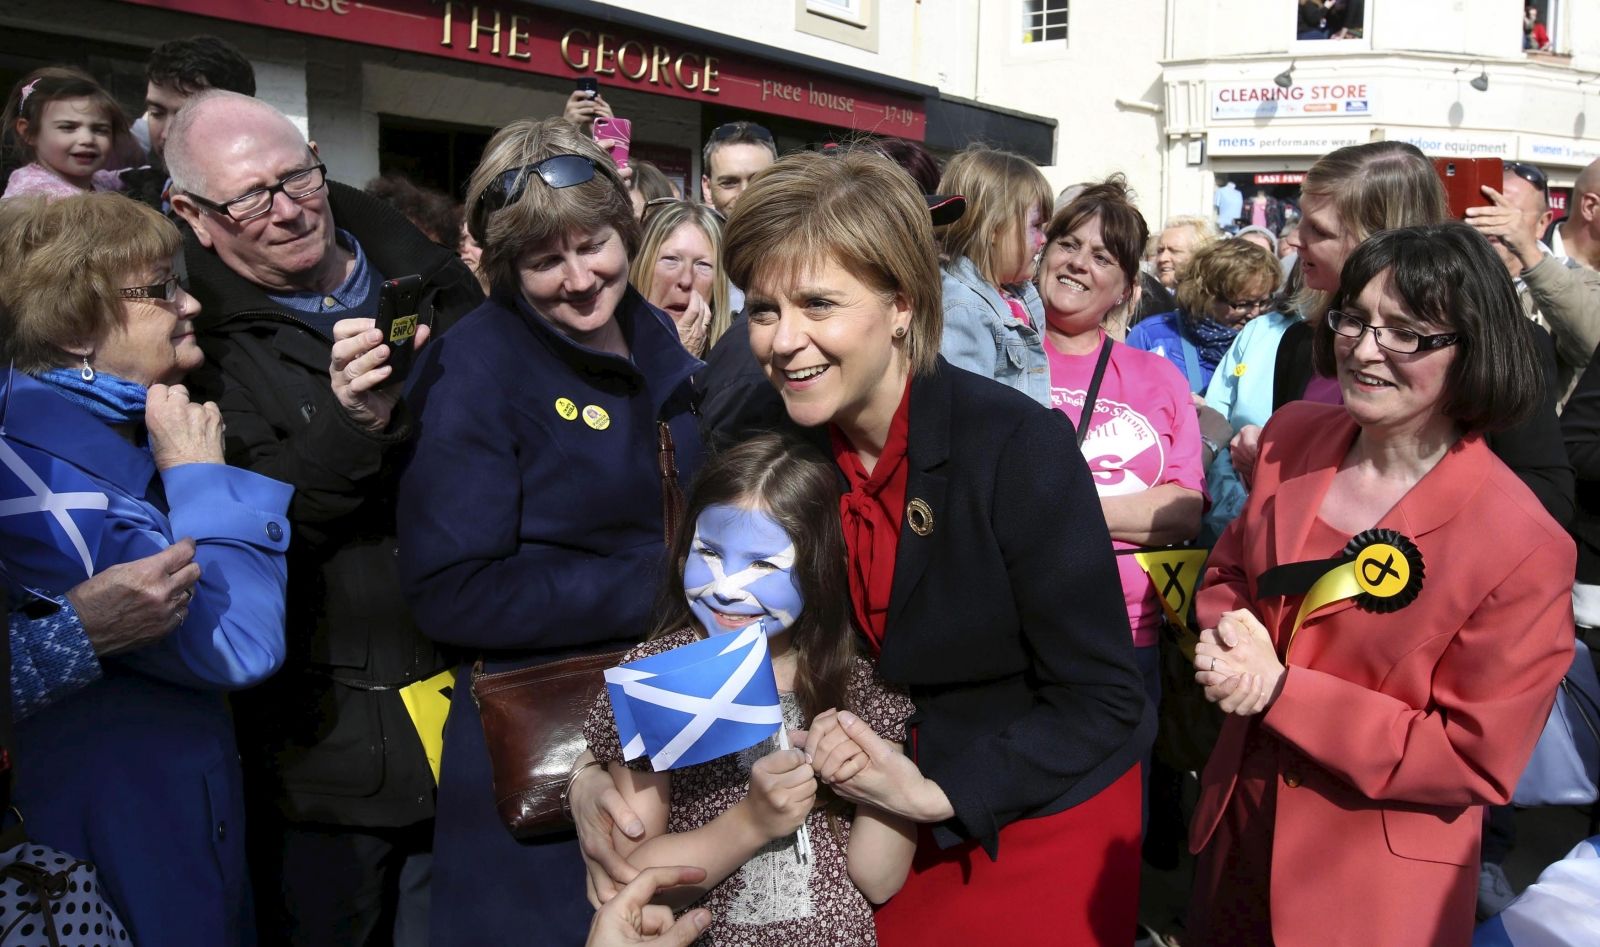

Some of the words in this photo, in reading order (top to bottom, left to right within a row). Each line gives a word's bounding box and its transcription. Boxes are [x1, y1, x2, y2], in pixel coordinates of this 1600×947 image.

[432, 0, 531, 59] THE
[560, 27, 720, 94] GEORGE
[809, 82, 856, 113] house
[1219, 87, 1304, 102] CLEARING
[1311, 85, 1366, 99] STORE
[1218, 137, 1255, 147] mens
[1259, 137, 1328, 150] performance
[1331, 138, 1358, 147] wear
[1402, 137, 1441, 150] tdoor
[1444, 139, 1507, 154] equipment
[1257, 175, 1280, 184] LAST
[1061, 392, 1086, 408] Insi
[1093, 402, 1110, 413] So
[1110, 407, 1150, 441] Strong
